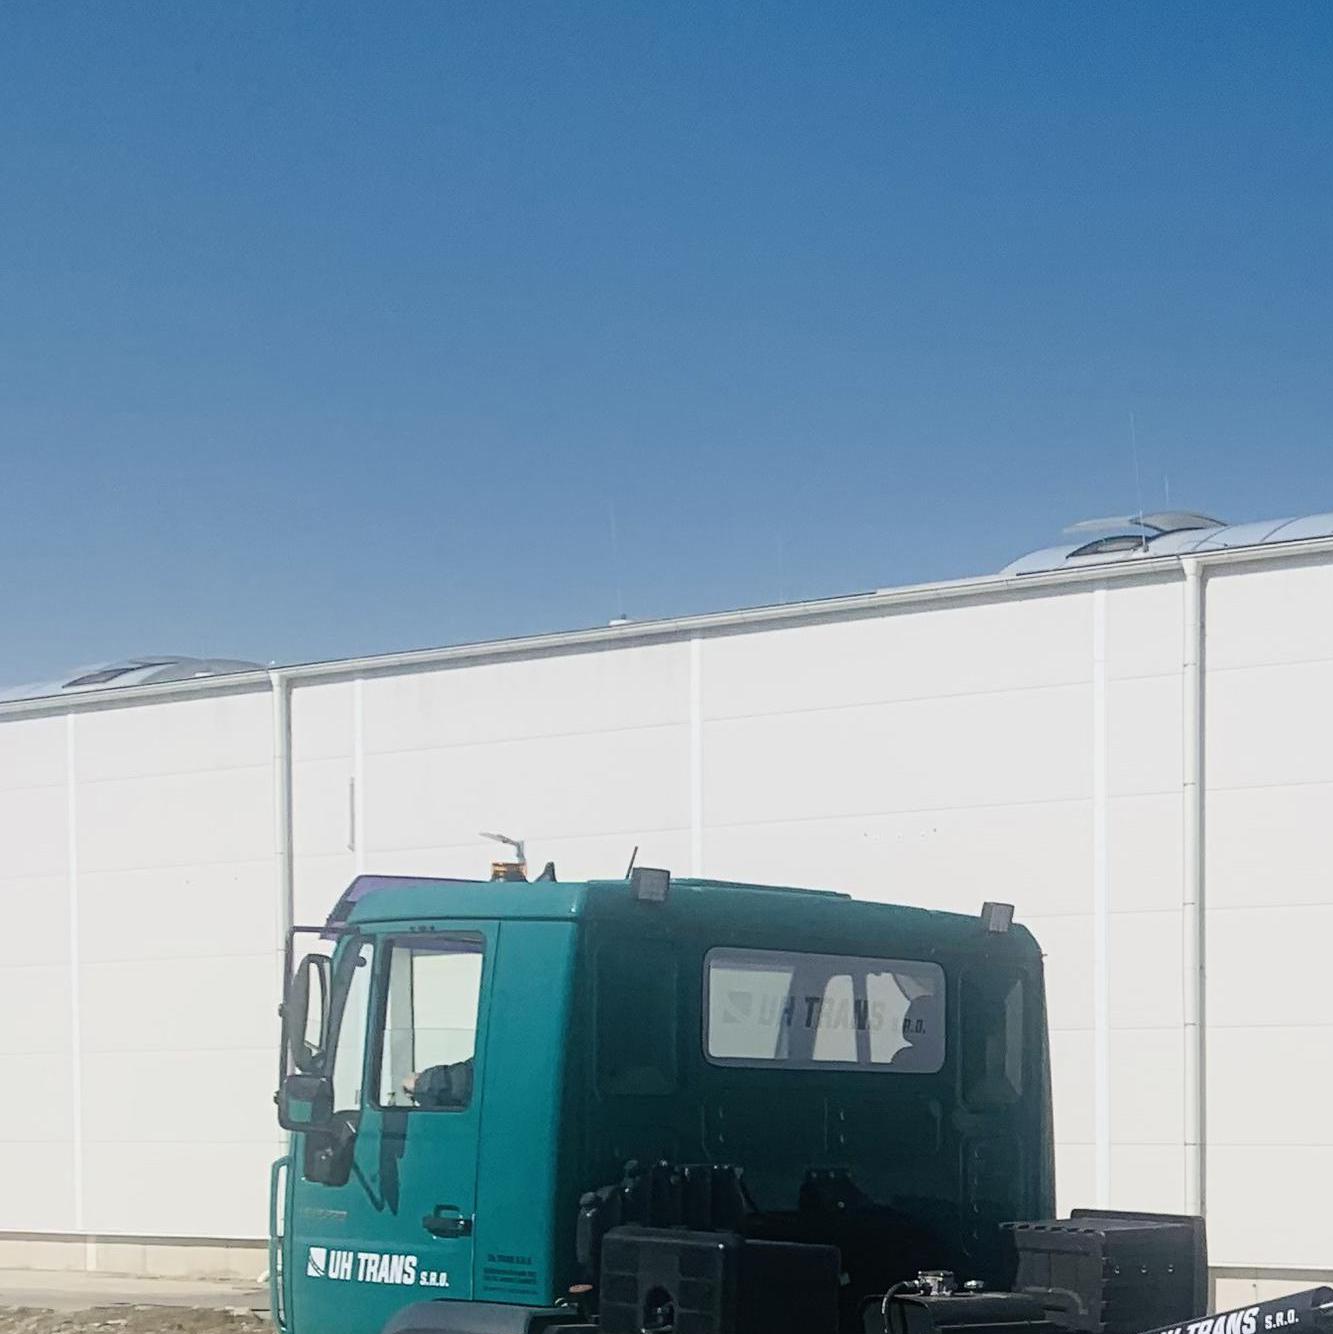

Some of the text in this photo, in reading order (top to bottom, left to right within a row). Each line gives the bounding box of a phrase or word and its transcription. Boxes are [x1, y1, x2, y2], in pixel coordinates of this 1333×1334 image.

[804, 996, 885, 1031] TRANS
[328, 1249, 353, 1281] UH
[357, 1252, 418, 1286] TRANS
[419, 1270, 449, 1288] S.R.O.
[1265, 1309, 1299, 1330] S.R.O.
